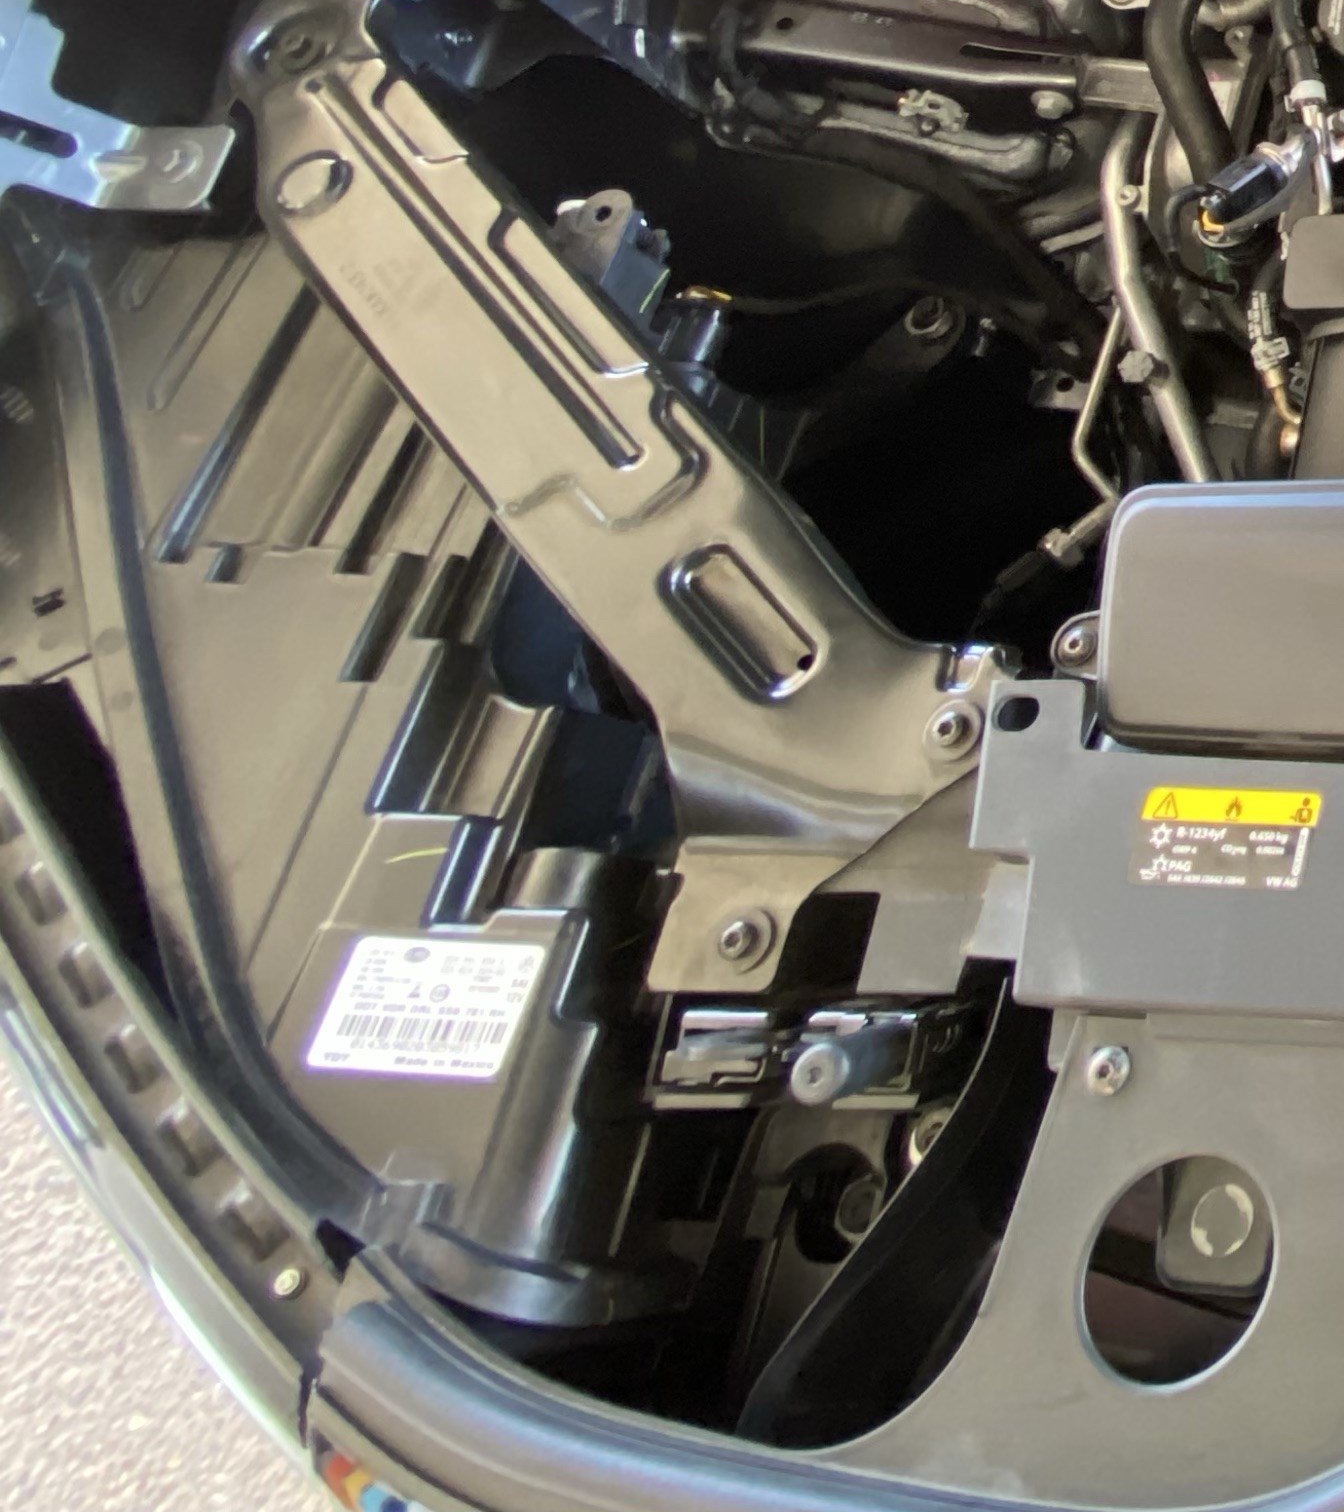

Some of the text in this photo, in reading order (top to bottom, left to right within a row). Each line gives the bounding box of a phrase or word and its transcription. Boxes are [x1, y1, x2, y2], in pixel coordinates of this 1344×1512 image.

[1170, 861, 1192, 873] PAG
[1267, 876, 1298, 888] VW AG
[450, 1058, 494, 1070] Mexico
